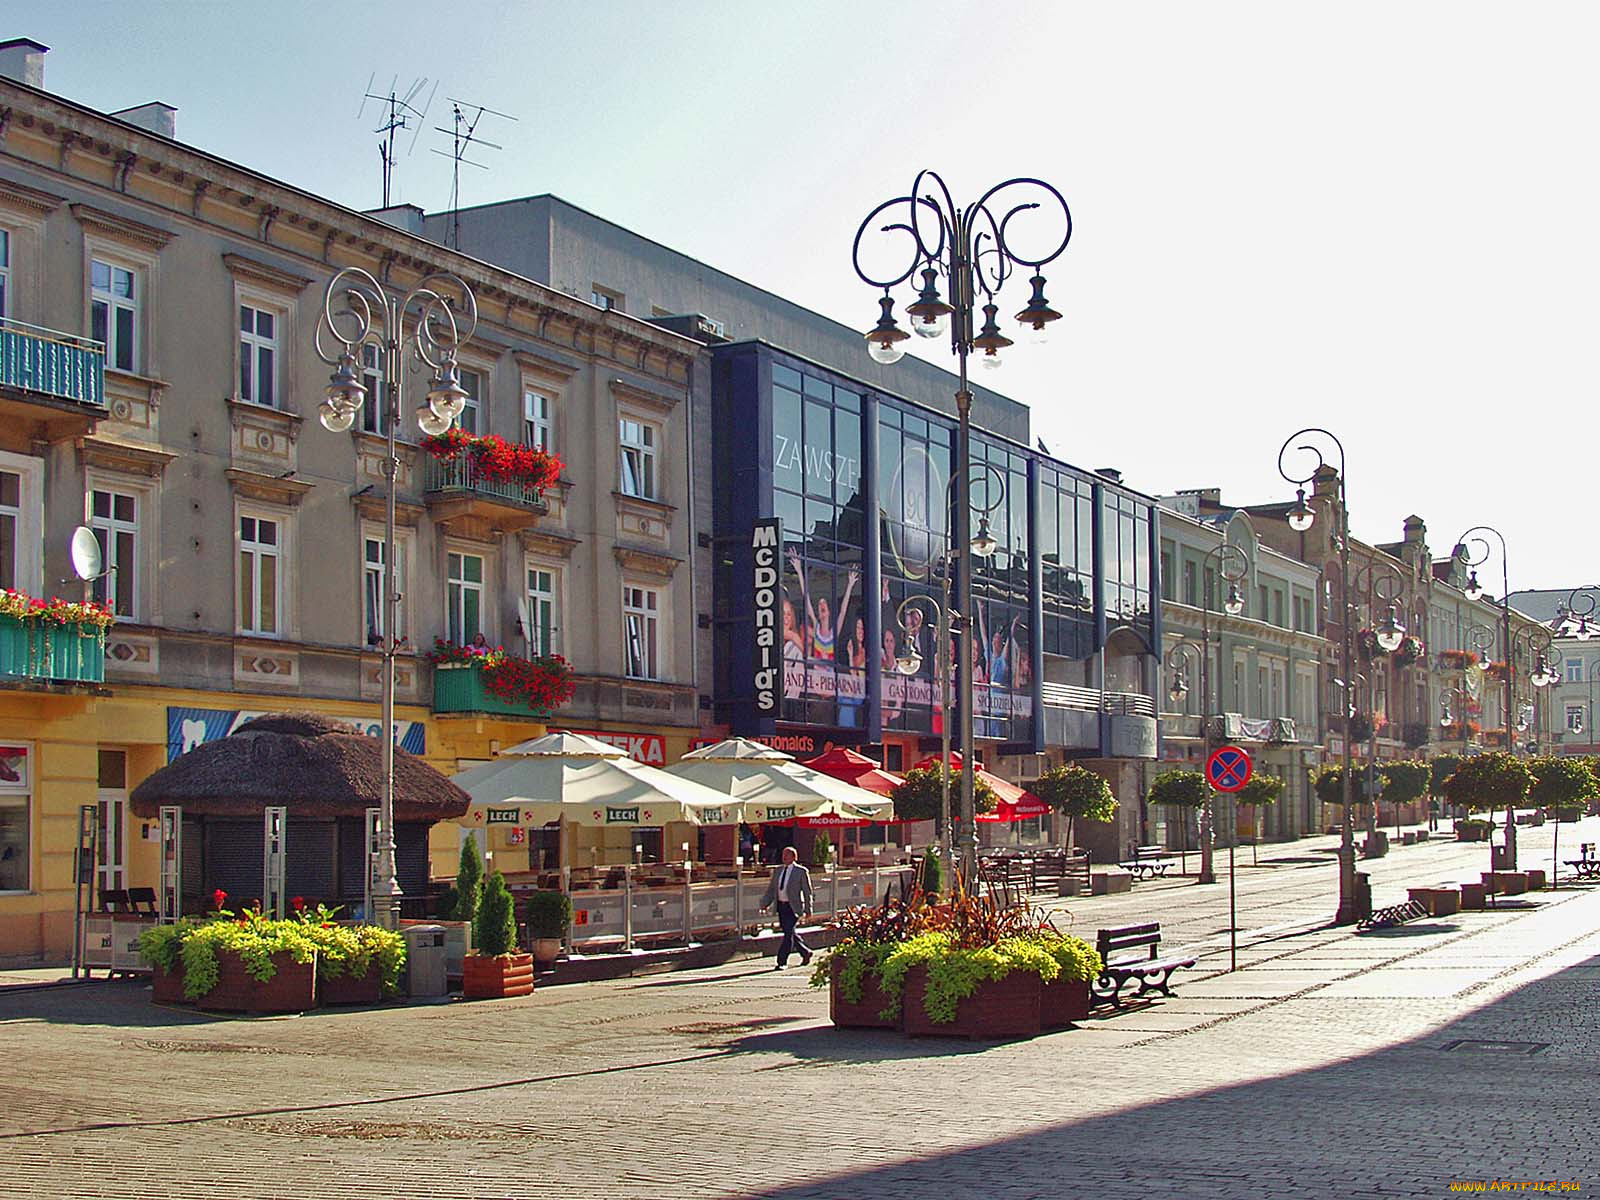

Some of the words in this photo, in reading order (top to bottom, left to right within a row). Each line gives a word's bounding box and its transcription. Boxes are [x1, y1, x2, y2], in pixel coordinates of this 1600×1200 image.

[775, 434, 857, 489] ZAWSZE
[752, 525, 778, 710] McDonald's
[785, 672, 814, 689] ANDEL
[888, 683, 941, 702] GASTRONOMI
[490, 812, 517, 821] LECH
[609, 810, 636, 820] LECH
[769, 809, 793, 818] LECH
